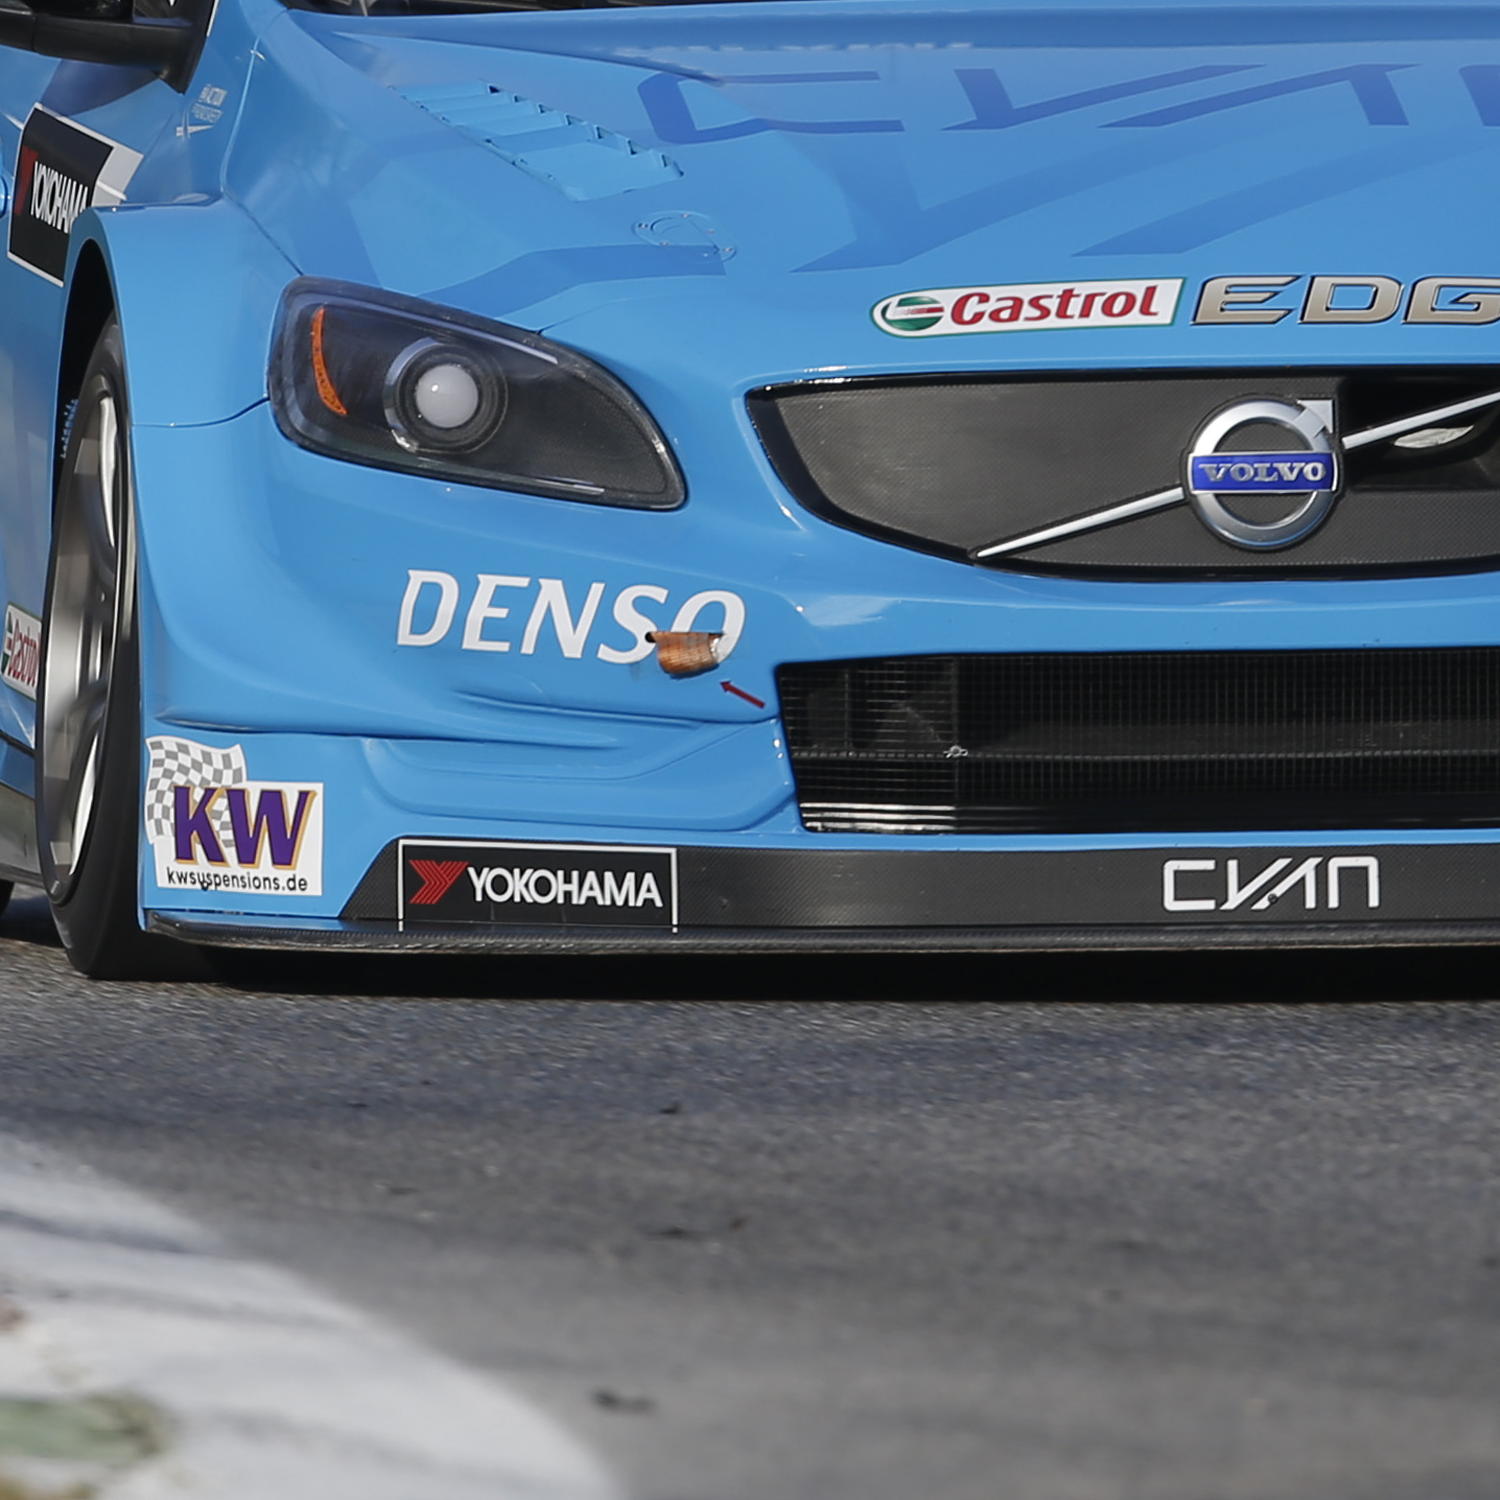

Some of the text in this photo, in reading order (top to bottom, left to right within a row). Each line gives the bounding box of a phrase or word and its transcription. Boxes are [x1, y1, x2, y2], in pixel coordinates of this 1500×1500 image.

[951, 285, 1158, 326] Castrol
[1198, 461, 1327, 482] VOLVO
[397, 569, 746, 664] DENSO
[174, 784, 318, 870] KW
[468, 866, 663, 908] YOKOHAMA
